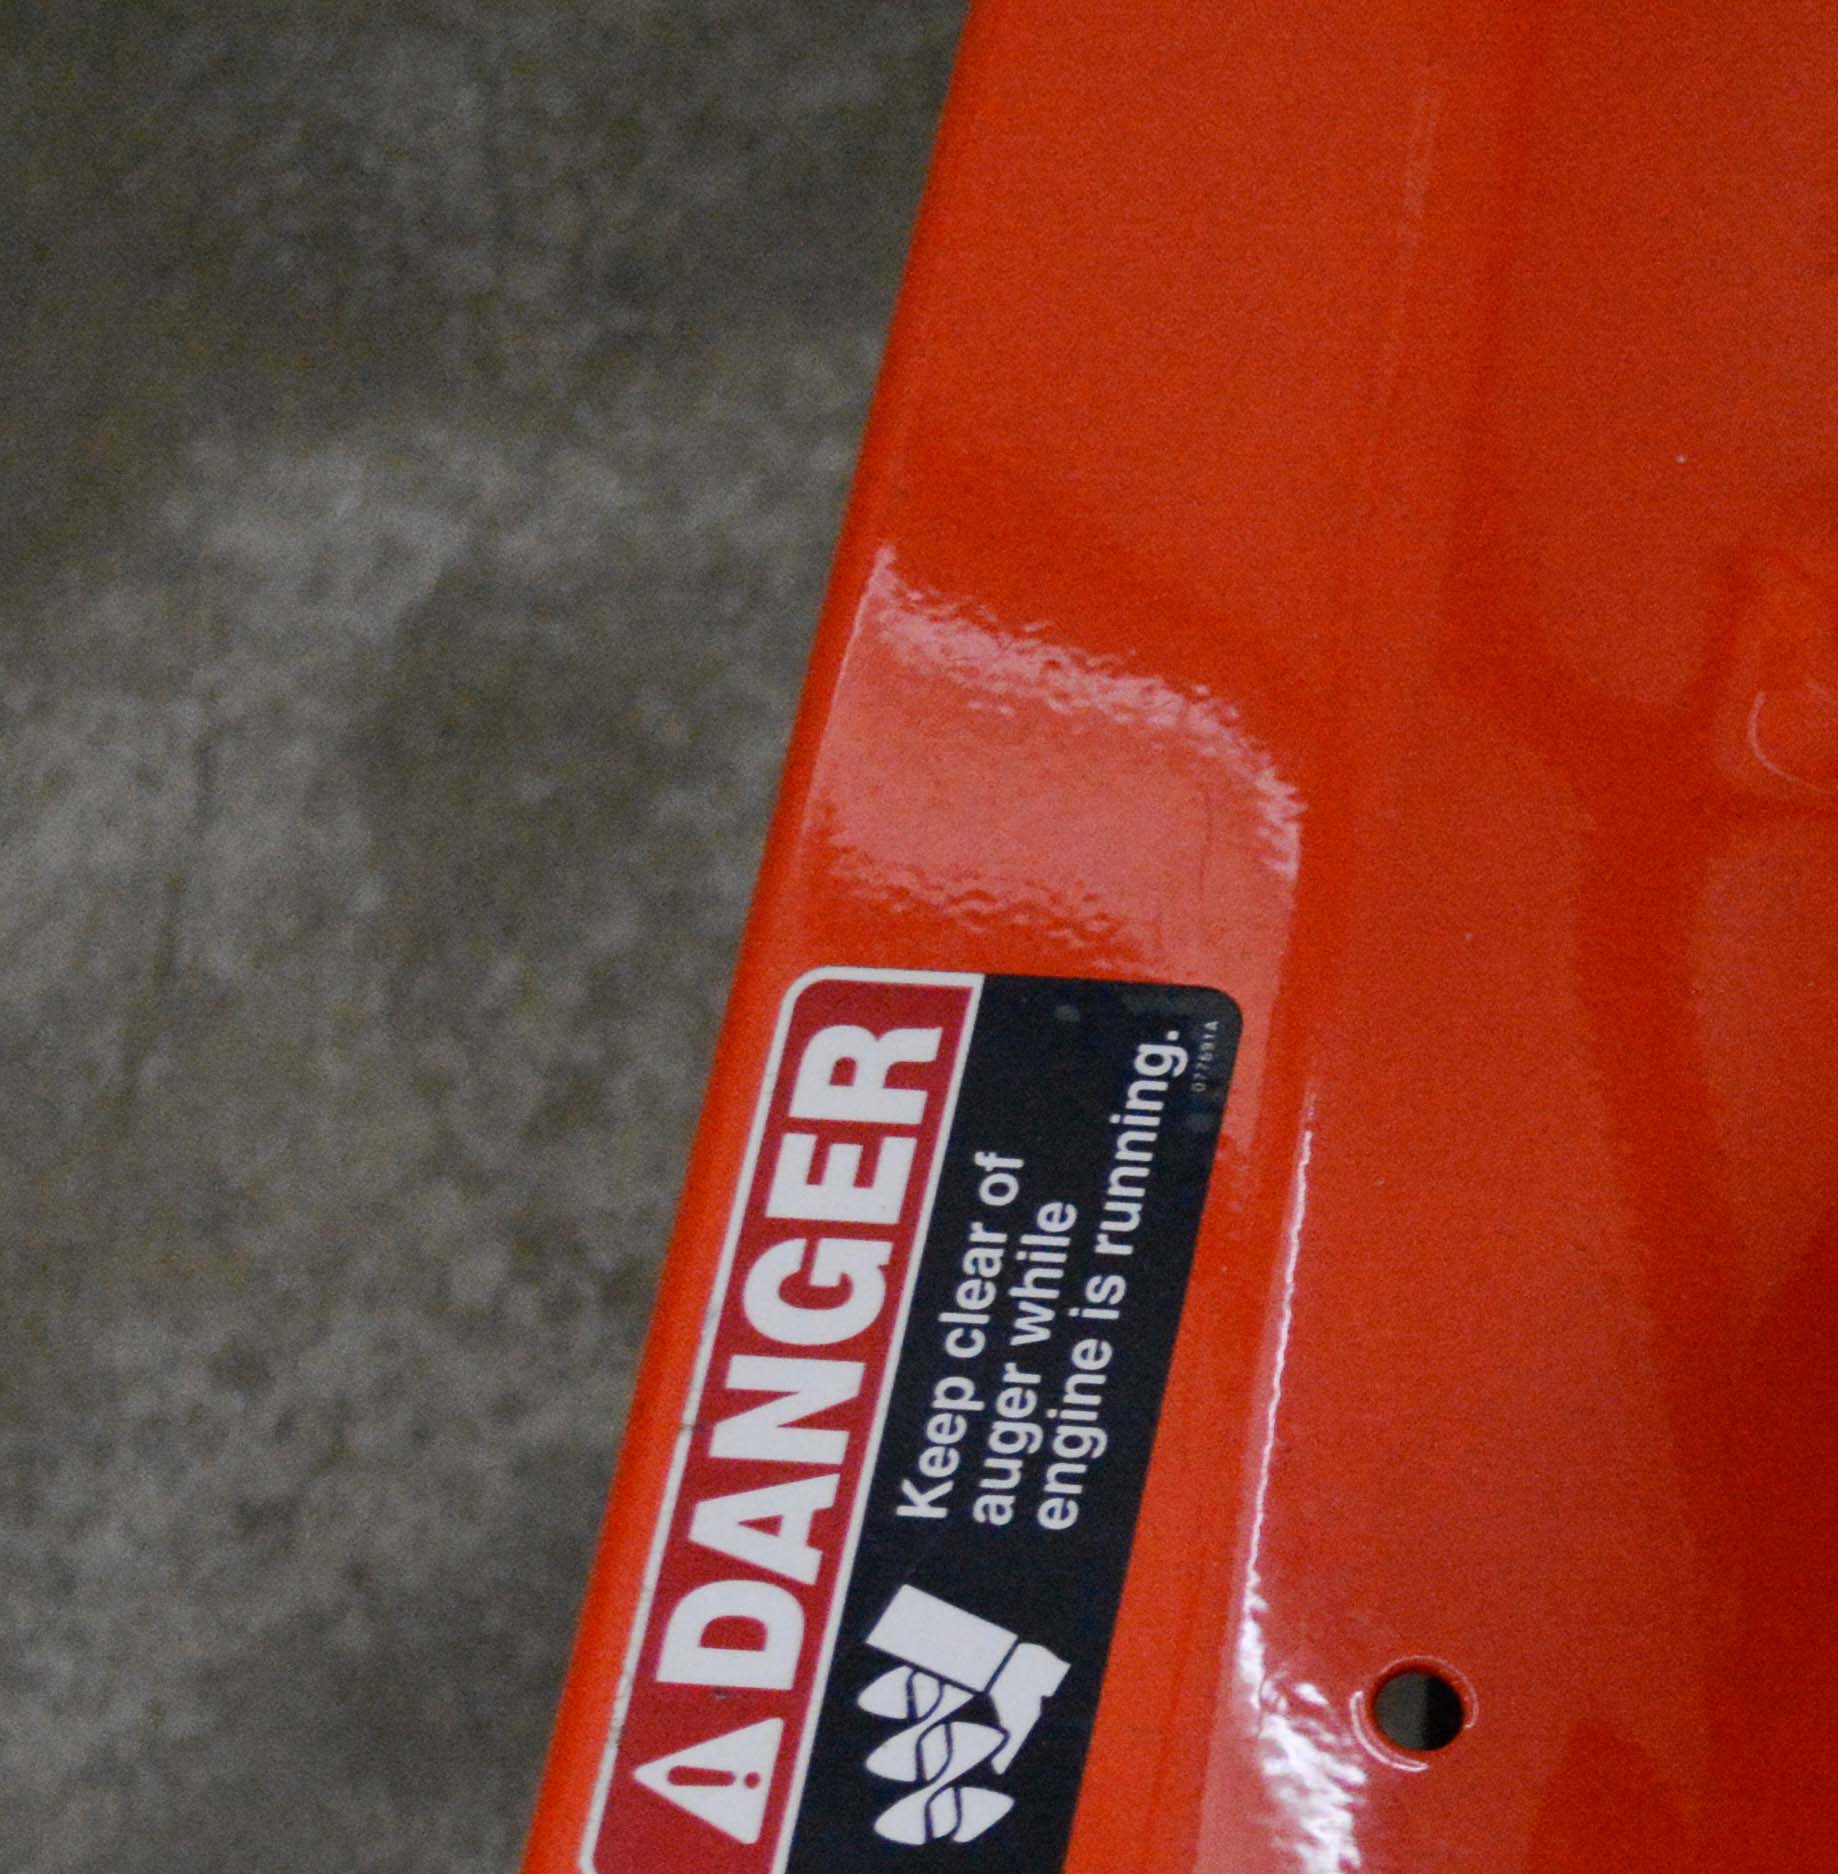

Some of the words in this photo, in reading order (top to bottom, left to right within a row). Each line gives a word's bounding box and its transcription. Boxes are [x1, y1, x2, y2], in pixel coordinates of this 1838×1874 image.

[973, 1150, 1025, 1207] of
[1094, 1030, 1189, 1256] running.
[937, 1221, 1008, 1359] clear
[1007, 1201, 1078, 1347] while
[1067, 1274, 1127, 1321] is
[654, 1023, 944, 1692] DANGER
[895, 1375, 985, 1519] Keep
[972, 1361, 1044, 1526] auger
[1036, 1338, 1113, 1531] engine
